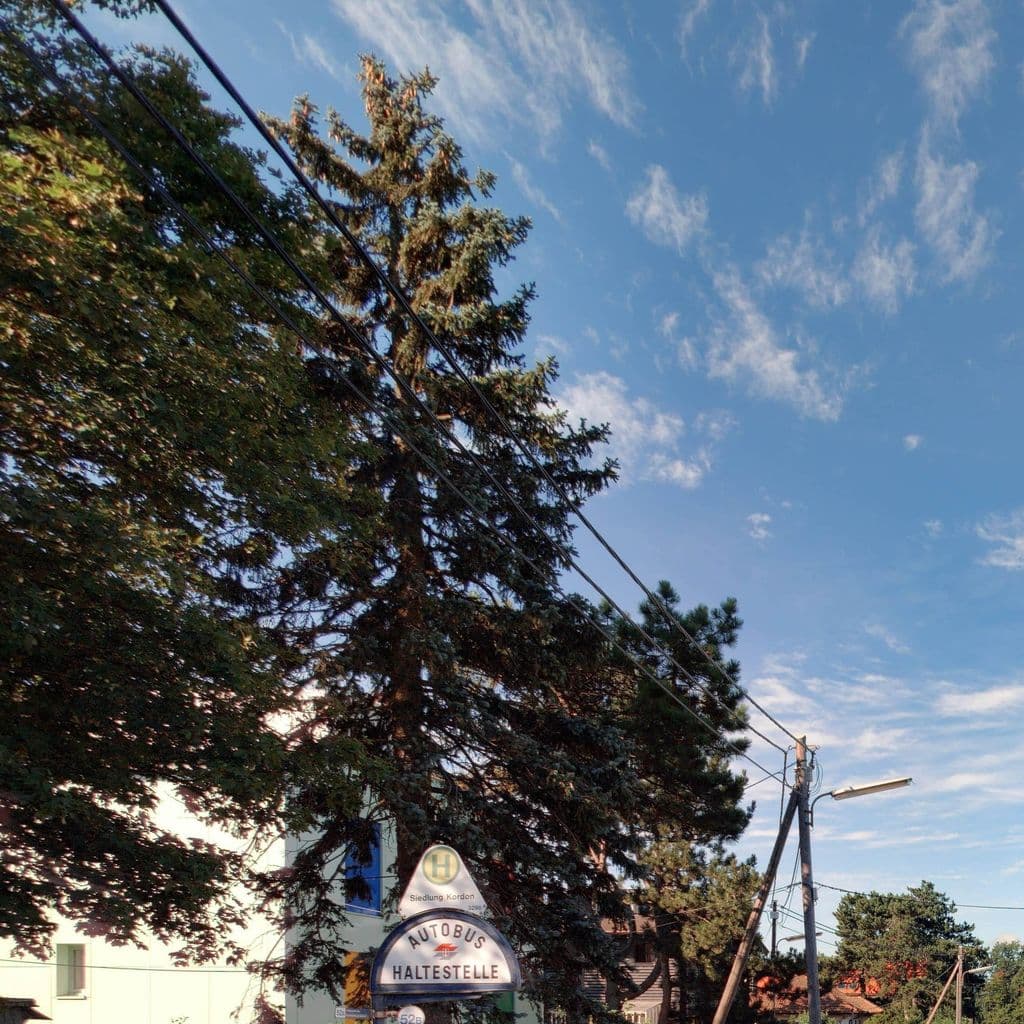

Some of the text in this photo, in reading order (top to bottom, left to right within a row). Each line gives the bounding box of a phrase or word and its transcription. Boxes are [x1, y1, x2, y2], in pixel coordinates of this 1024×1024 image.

[431, 854, 451, 878] H
[409, 893, 443, 902] Siedlung
[407, 922, 486, 950] AUTOBUS
[393, 964, 499, 980] HALTESTELLE
[400, 1014, 421, 1024] 52B
